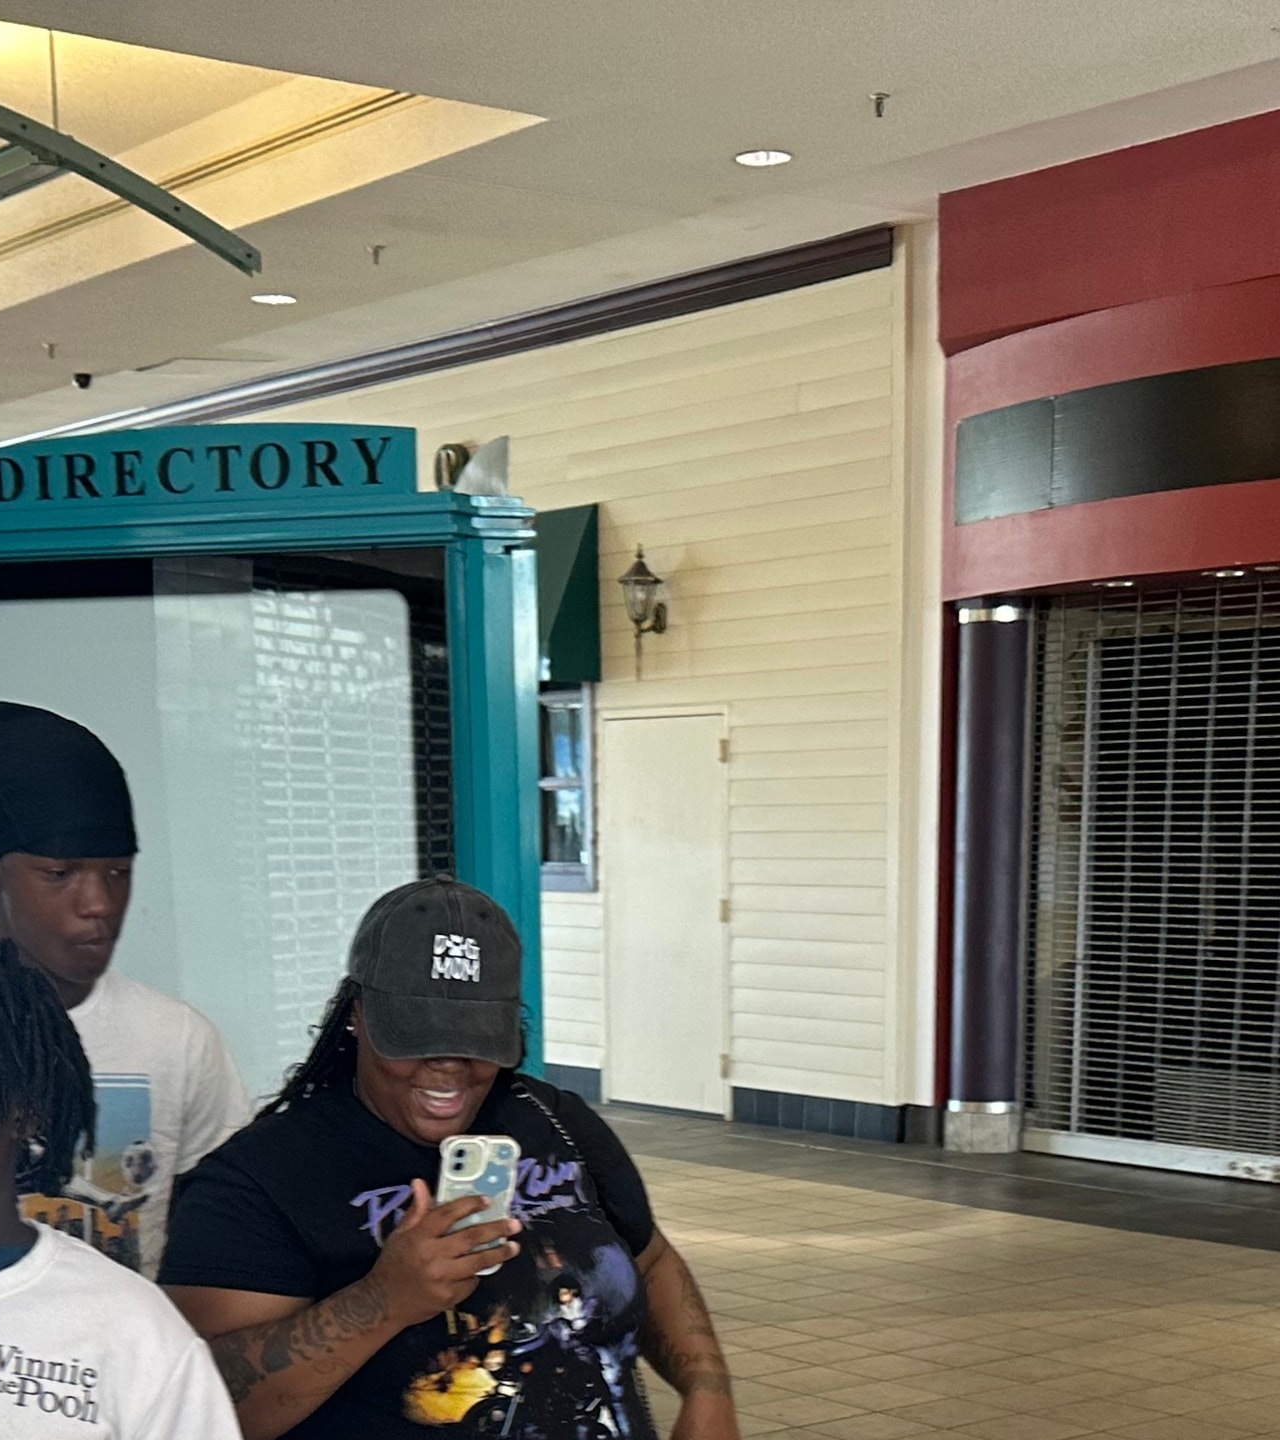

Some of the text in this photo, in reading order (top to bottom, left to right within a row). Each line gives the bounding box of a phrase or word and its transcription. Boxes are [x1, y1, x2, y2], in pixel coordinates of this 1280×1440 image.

[433, 933, 481, 960] DOG
[431, 956, 481, 983] MOM
[14, 1376, 99, 1424] Pooh
